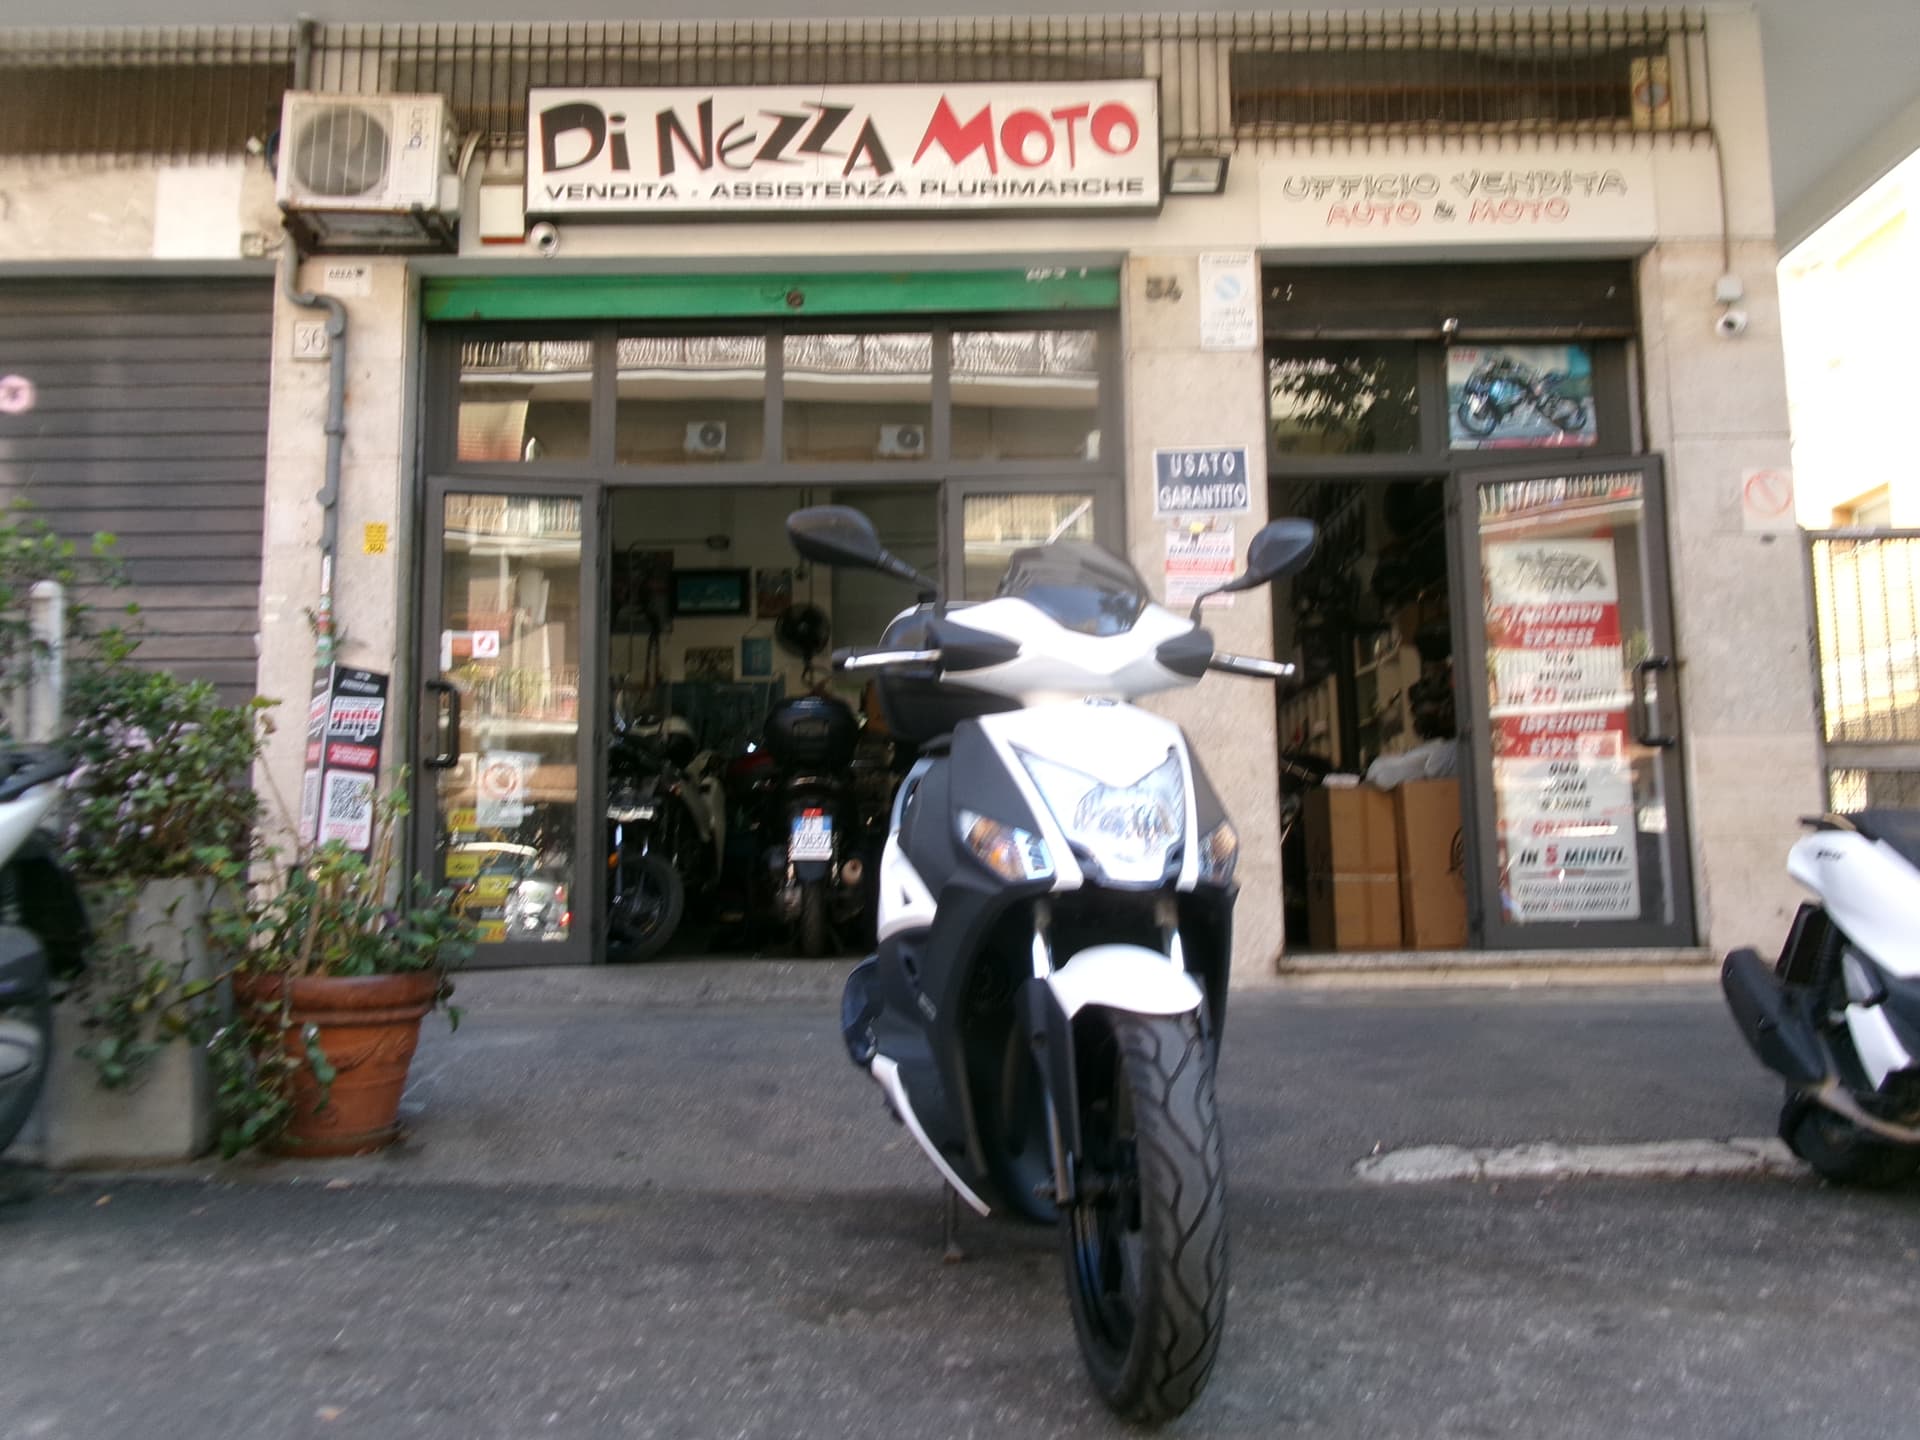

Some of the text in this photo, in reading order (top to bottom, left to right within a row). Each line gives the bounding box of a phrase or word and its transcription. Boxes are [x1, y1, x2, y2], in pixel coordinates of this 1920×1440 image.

[911, 94, 1140, 175] MOTO
[546, 178, 1145, 199] VENDITA ASSISTENZA PLURIMARCHE
[1283, 169, 1628, 201] UFFICIO VENDITA
[1326, 201, 1422, 226] AUTO
[1468, 197, 1571, 224] MOTO
[300, 330, 327, 351] 36
[1170, 452, 1235, 478] USATO
[1160, 483, 1246, 510] GARANTITO
[1523, 627, 1596, 647] EXPRESS
[333, 707, 379, 720] moto
[1520, 714, 1608, 733] ISPEZIONE
[331, 717, 377, 736] days
[1519, 845, 1625, 867] IN 5 MINUTI
